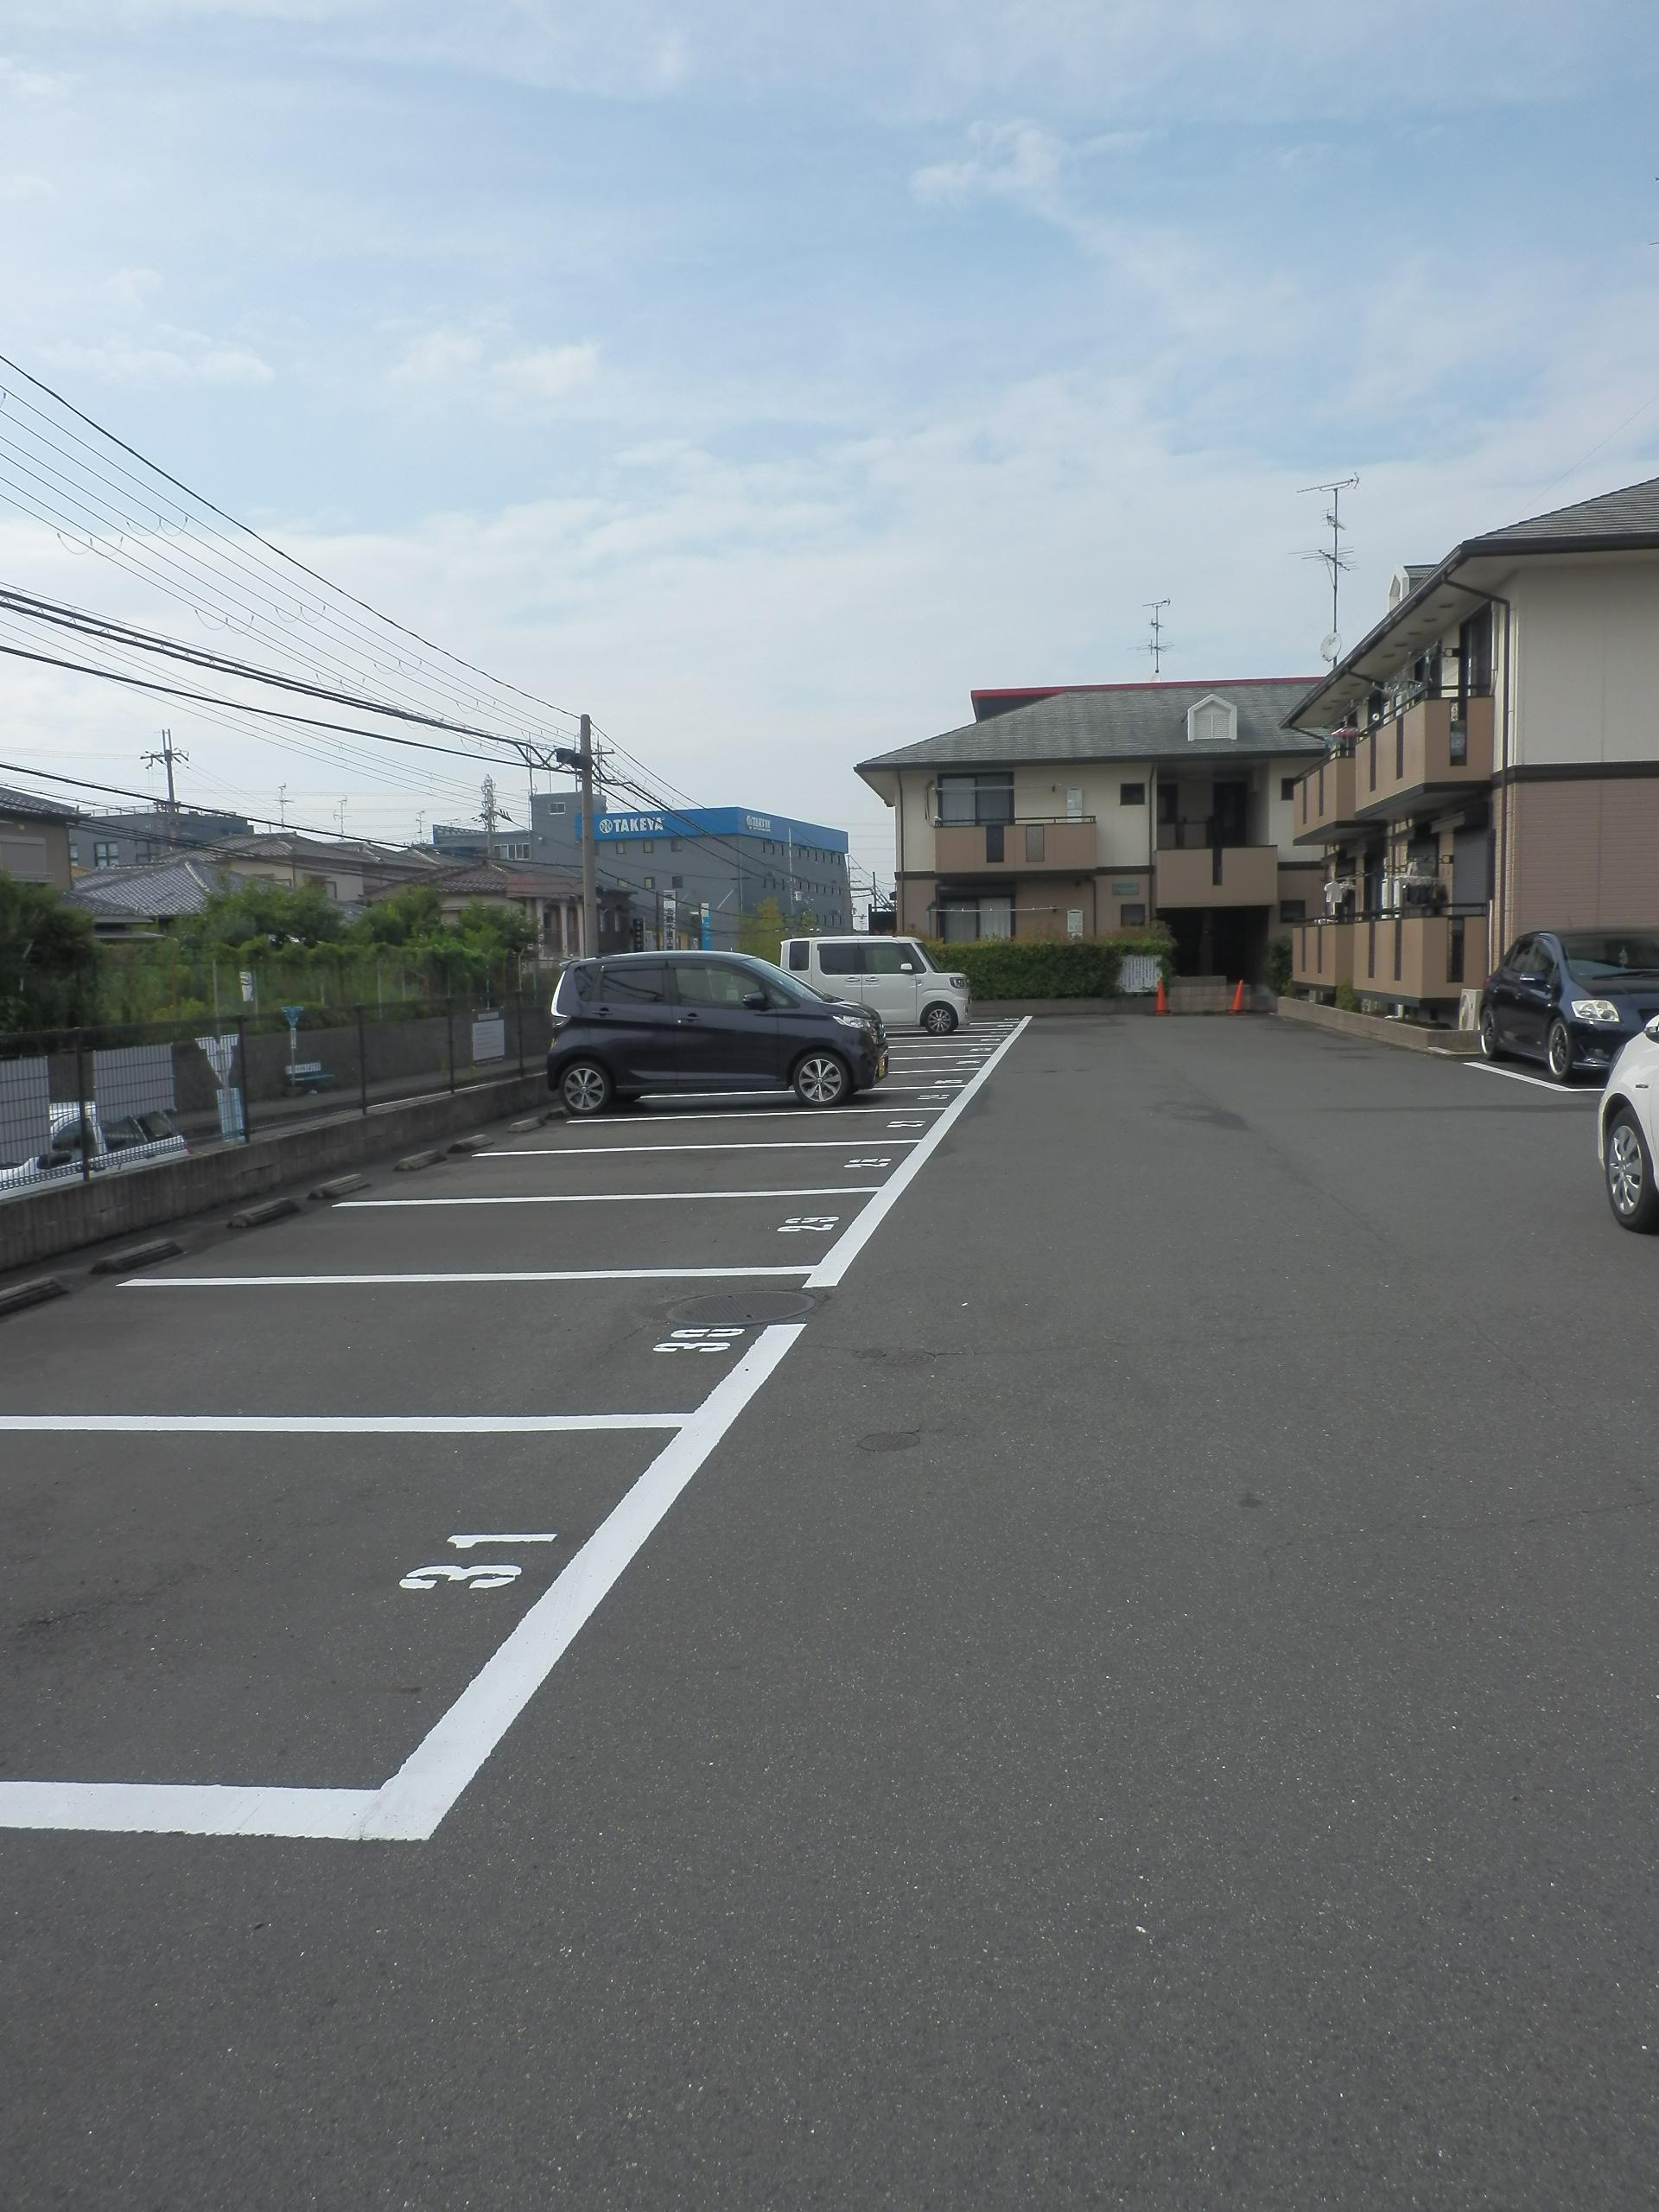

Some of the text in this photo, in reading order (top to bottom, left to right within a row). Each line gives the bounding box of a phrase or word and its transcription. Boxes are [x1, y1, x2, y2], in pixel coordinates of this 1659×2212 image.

[613, 817, 664, 833] TAKEYA
[844, 1159, 892, 1168] 28
[777, 1216, 840, 1232] 29
[653, 1328, 745, 1352] 30
[399, 1534, 557, 1589] 31
